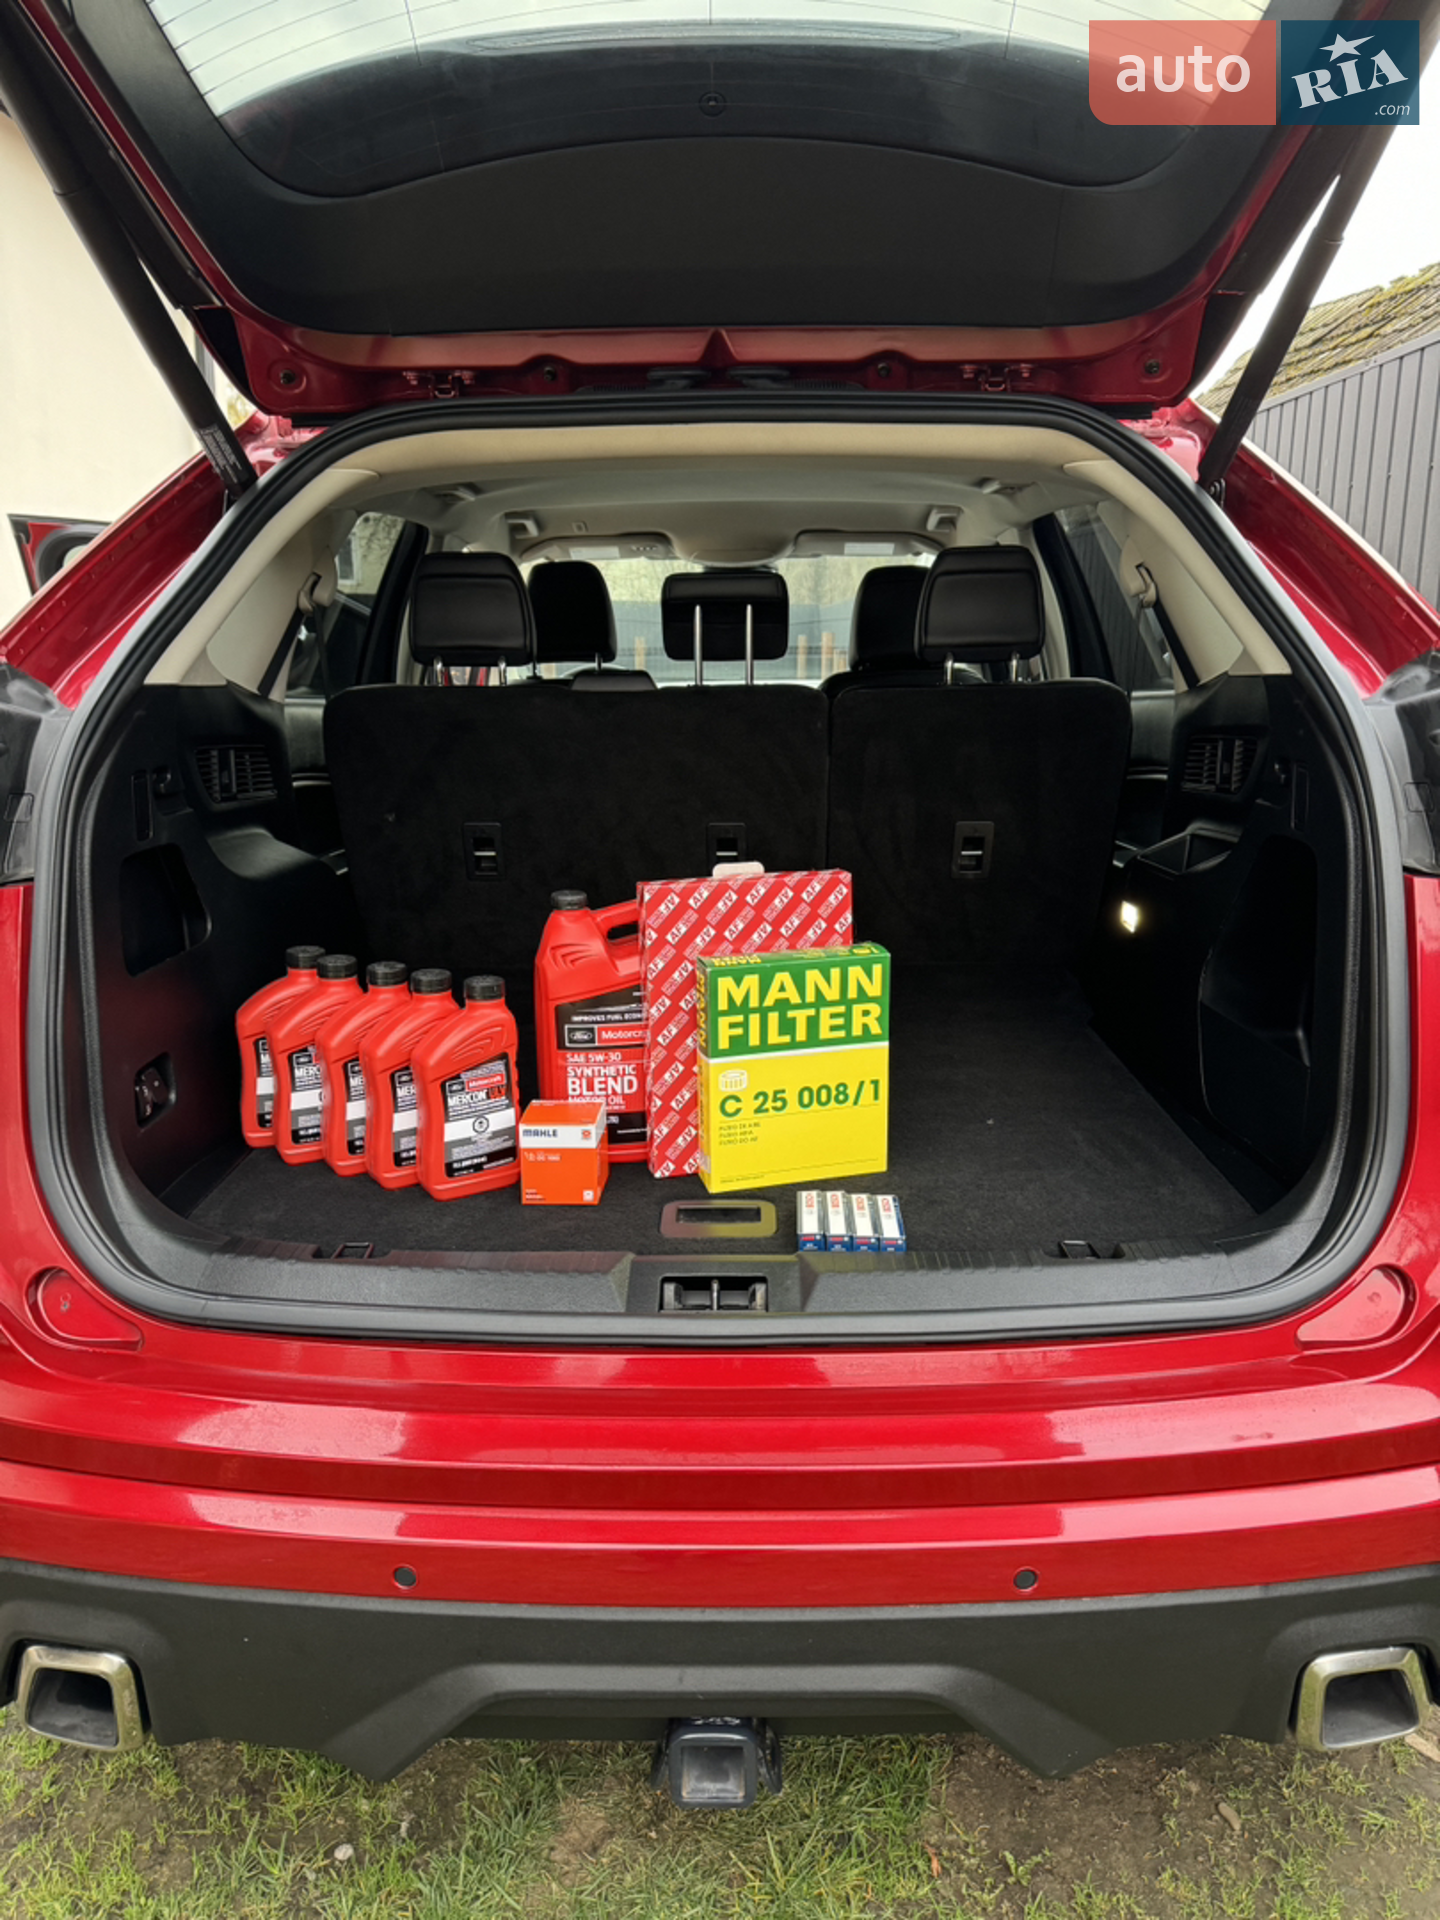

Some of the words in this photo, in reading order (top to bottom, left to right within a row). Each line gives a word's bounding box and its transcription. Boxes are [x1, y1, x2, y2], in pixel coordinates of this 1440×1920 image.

[717, 963, 883, 1011] MANN
[717, 1002, 883, 1050] FILTER
[566, 1053, 587, 1063] SAE
[588, 1052, 621, 1063] 5W-30
[567, 1064, 637, 1077] SYNTHETIC
[568, 1075, 639, 1096] BLEND
[448, 1089, 487, 1106] MERCON
[608, 1095, 626, 1105] OIL
[719, 1094, 743, 1118] C
[753, 1088, 788, 1115] 25
[797, 1079, 880, 1110] 008/1
[523, 1129, 558, 1137] MAHLE
